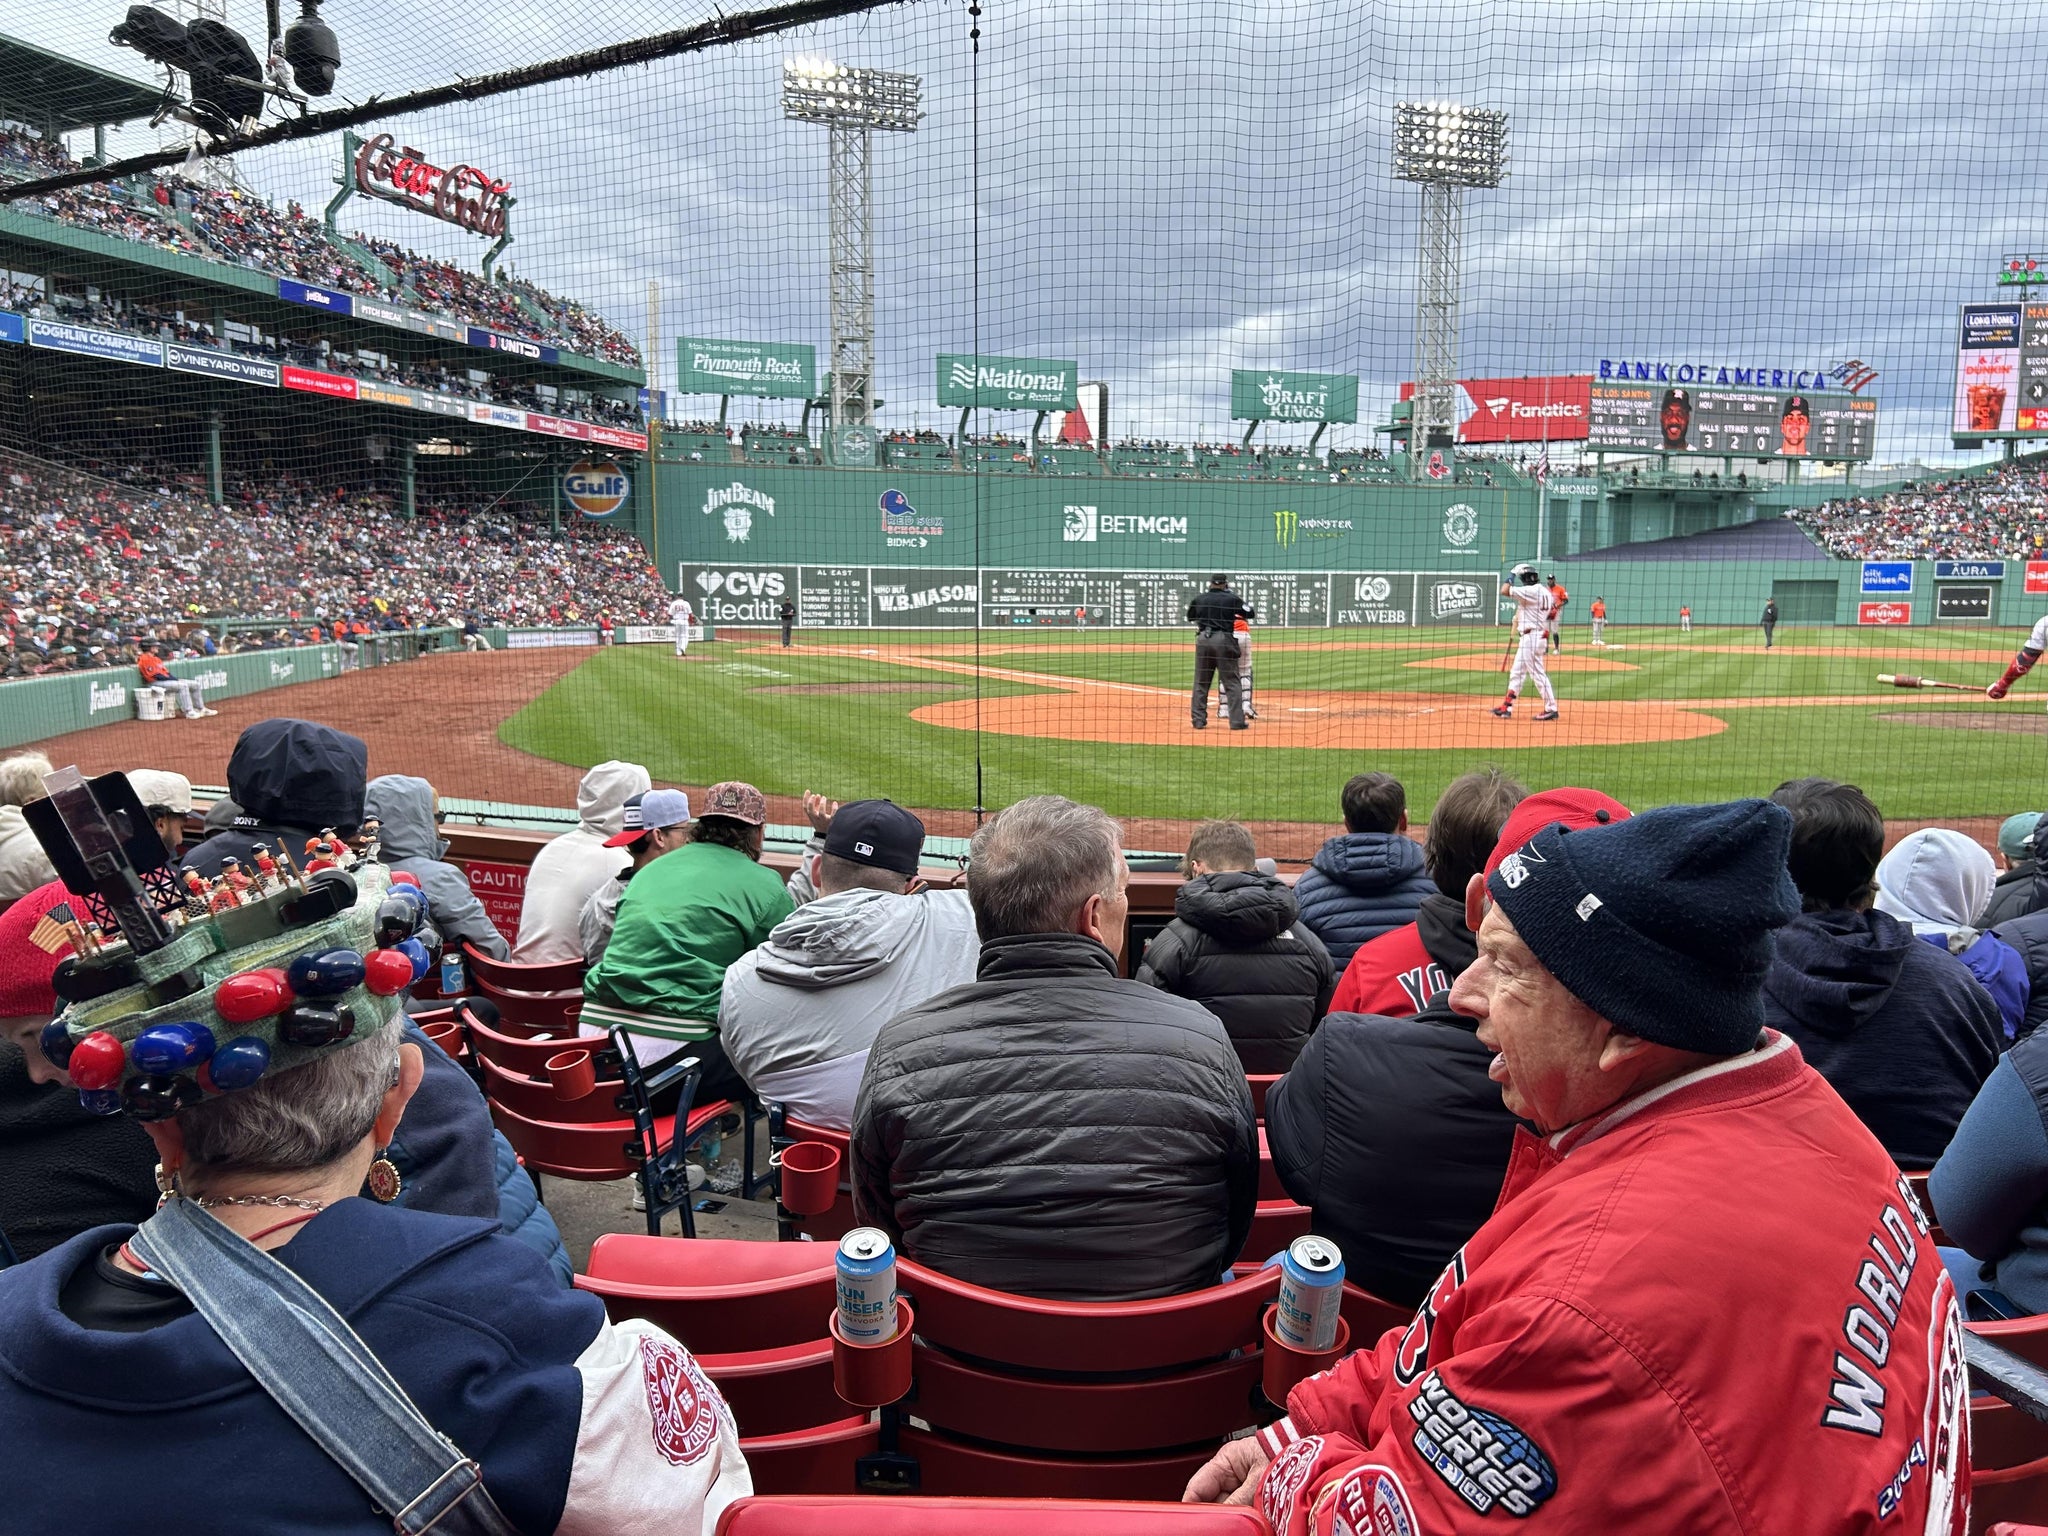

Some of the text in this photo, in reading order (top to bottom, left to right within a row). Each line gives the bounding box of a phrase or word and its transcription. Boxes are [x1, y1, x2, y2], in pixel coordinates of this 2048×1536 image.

[306, 290, 330, 304] jetBlue
[1969, 314, 2014, 325] LONG HOME
[32, 323, 160, 355] COGHLIN COMPANIES
[501, 338, 540, 358] UNITED
[180, 353, 275, 379] VINEYARD VINES
[693, 353, 802, 374] Plymouth Rock
[1966, 366, 2013, 375] DUNKIN'
[1600, 359, 1825, 390] BANK OF AMERICA
[1008, 391, 1062, 402] Car Rental
[1263, 388, 1328, 405] DRAFT
[1592, 388, 1602, 397] DE
[1604, 389, 1619, 398] LOS
[1270, 404, 1324, 418] KINGS
[1511, 401, 1582, 418] Fanatics
[1699, 424, 1770, 434] BALLS STRIKES OUTS
[1704, 434, 1765, 450] 3 2 0
[565, 475, 624, 495] Gulf
[1552, 483, 1598, 496] ABIOMED
[702, 482, 776, 517] JIM BEAM
[887, 517, 914, 525] RED
[1100, 515, 1187, 534] BETMGM
[887, 526, 944, 535] SCHOLARS
[887, 538, 917, 547] BIDMC
[725, 571, 785, 596] CVS
[1440, 584, 1477, 599] ACE
[700, 597, 782, 620] Health
[1441, 598, 1478, 609] TICKET
[1366, 610, 1406, 623] WEBB
[1866, 608, 1902, 618] IRVING
[234, 816, 261, 826] SONY
[493, 901, 520, 911] CLEAR
[492, 914, 503, 922] BE
[838, 1281, 865, 1301] SUN
[1821, 1203, 1918, 1438] WORLD
[682, 1408, 712, 1452] WORLD
[1421, 1369, 1543, 1492] WORLD
[1410, 1395, 1536, 1516] SERIES
[1878, 1437, 1927, 1520] 2004
[1377, 1480, 1400, 1515] WORLD
[1344, 1477, 1373, 1536] RED
